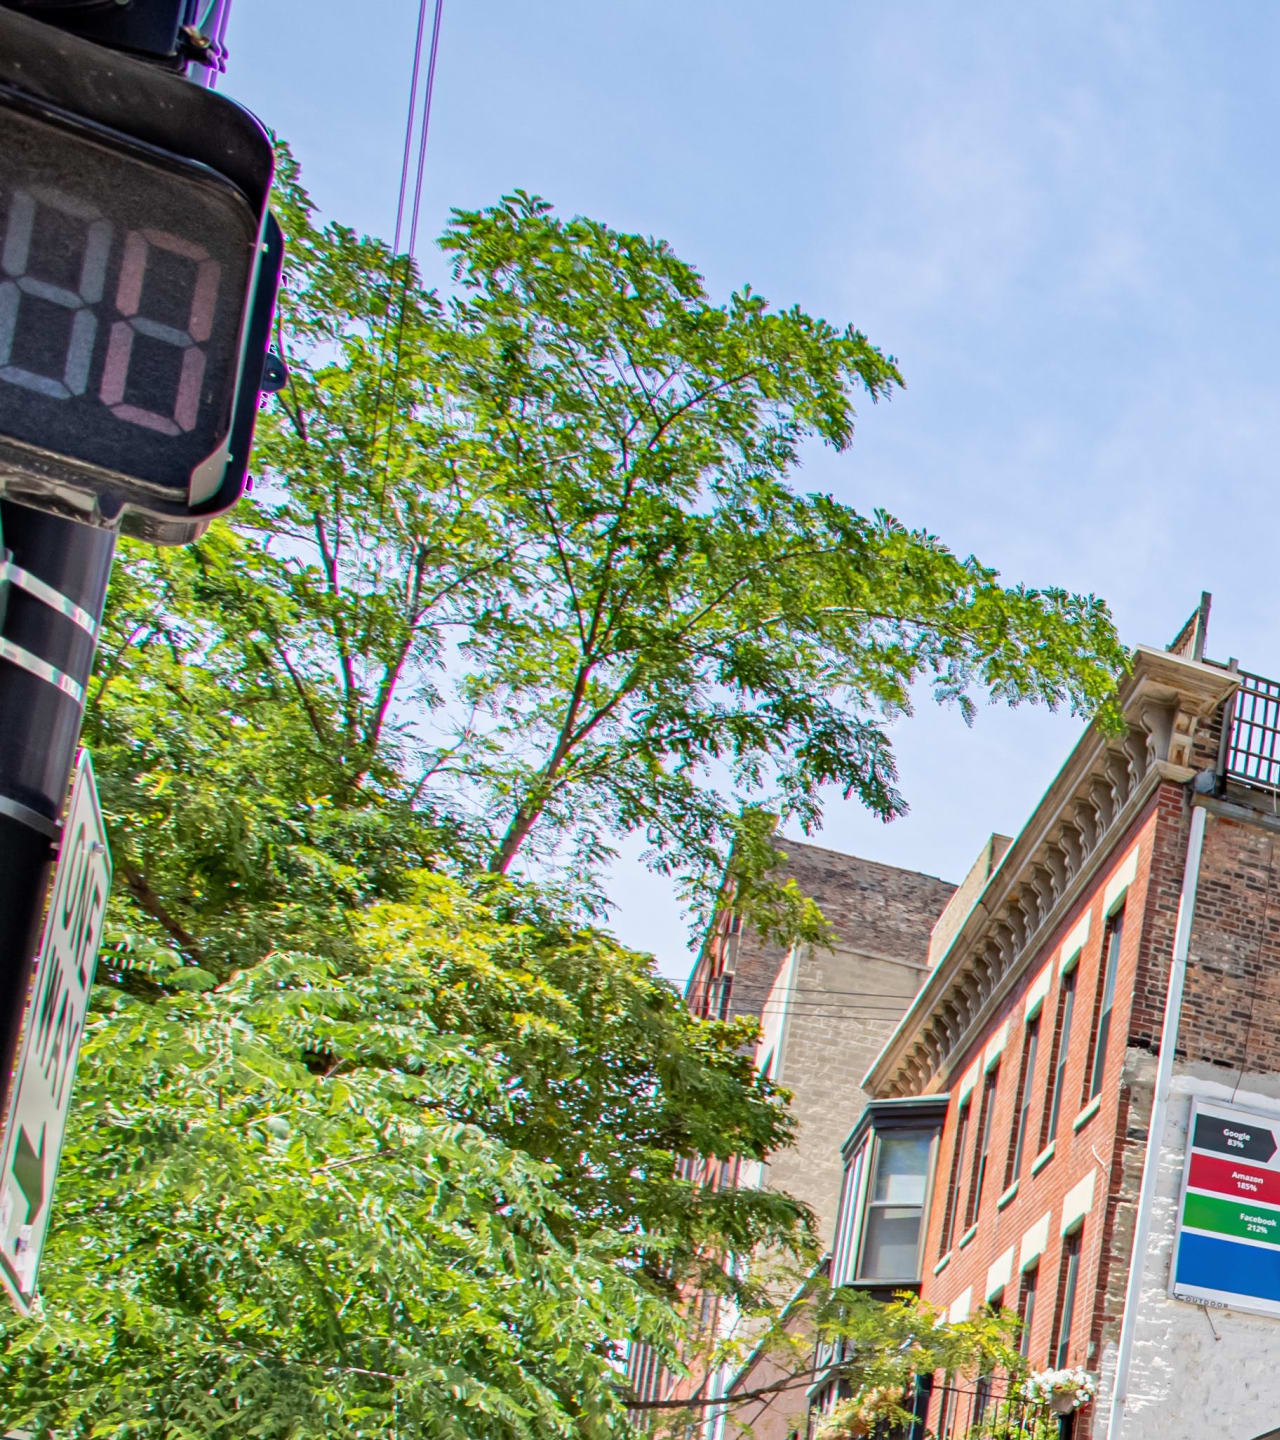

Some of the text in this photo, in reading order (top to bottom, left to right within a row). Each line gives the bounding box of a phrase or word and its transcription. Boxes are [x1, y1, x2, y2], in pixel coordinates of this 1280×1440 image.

[62, 821, 102, 992] ONE
[35, 944, 81, 1111] WAY
[1223, 1128, 1251, 1142] Google
[1227, 1138, 1244, 1149] 83%
[1231, 1171, 1264, 1184] Amazon
[1236, 1181, 1258, 1193] 185%
[1239, 1212, 1277, 1227] Facebook
[1246, 1223, 1268, 1234] 212%
